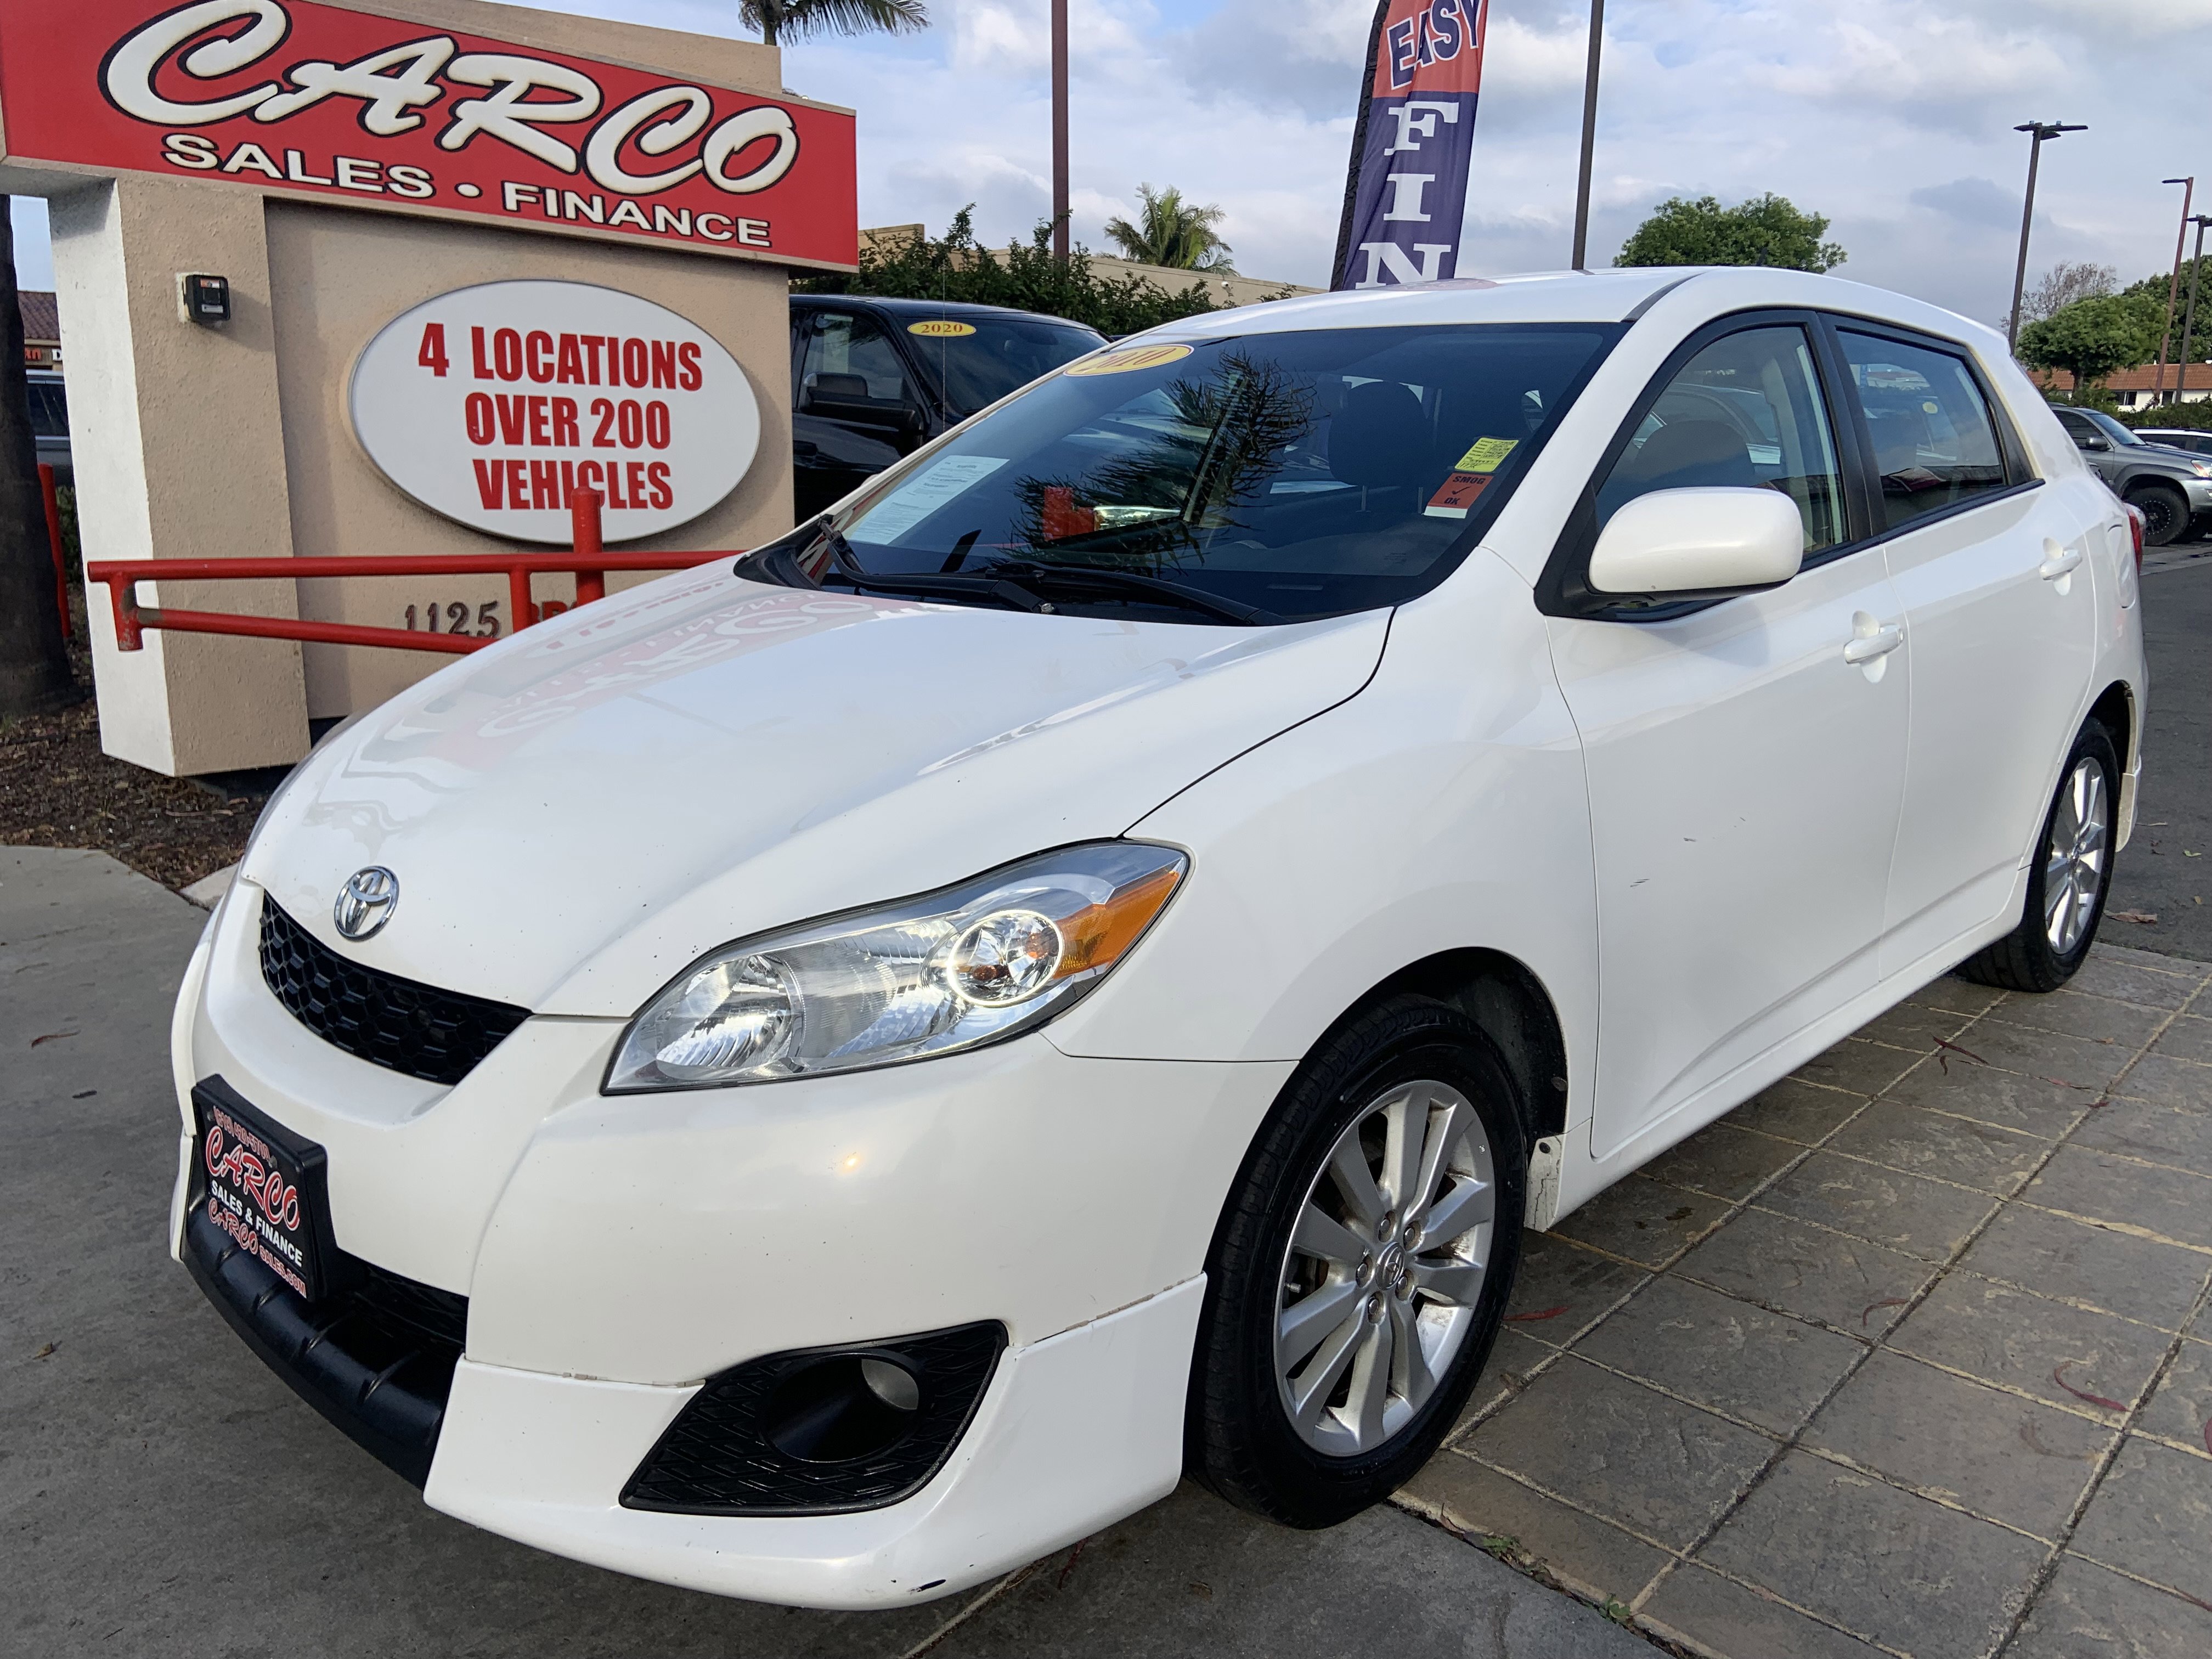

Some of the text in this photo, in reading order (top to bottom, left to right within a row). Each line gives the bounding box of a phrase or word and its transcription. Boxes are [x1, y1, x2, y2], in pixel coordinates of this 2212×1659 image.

[1386, 0, 1481, 90] EASY
[98, 0, 800, 195] CARCO
[161, 134, 772, 247] SALES FINANCE
[417, 323, 703, 391] 4 LOCATIONS
[921, 324, 963, 334] 2020
[465, 392, 671, 450] OVER 200
[472, 459, 674, 511] VEHICLES
[1444, 497, 1460, 505] OK
[1453, 476, 1486, 484] SMOG
[405, 600, 500, 637] 1125
[206, 1125, 300, 1231] CARCO
[208, 1197, 259, 1255] CARCO
[211, 1180, 303, 1267] SALES & FINANCE
